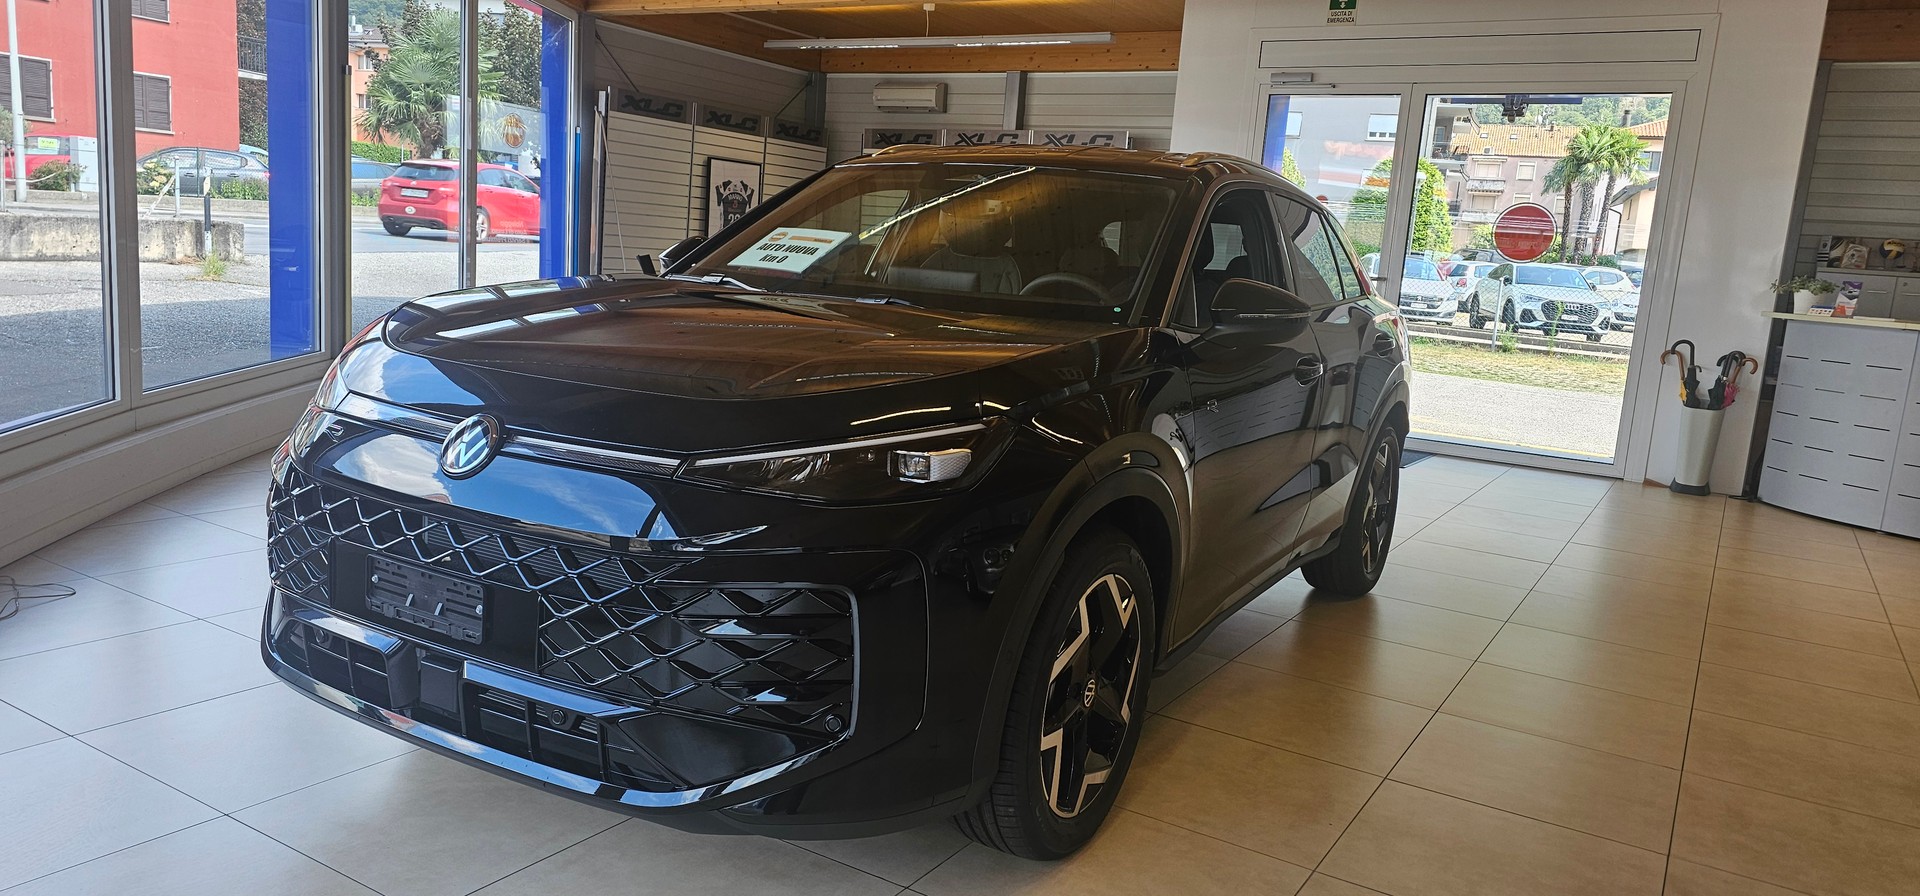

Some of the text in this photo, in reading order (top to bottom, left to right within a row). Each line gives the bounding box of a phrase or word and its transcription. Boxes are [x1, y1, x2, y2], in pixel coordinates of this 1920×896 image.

[621, 95, 684, 118] XLC
[706, 110, 758, 132] XLC
[776, 122, 821, 142] XLC
[756, 243, 819, 256] AUTO NUOVA
[759, 254, 776, 263] Km
